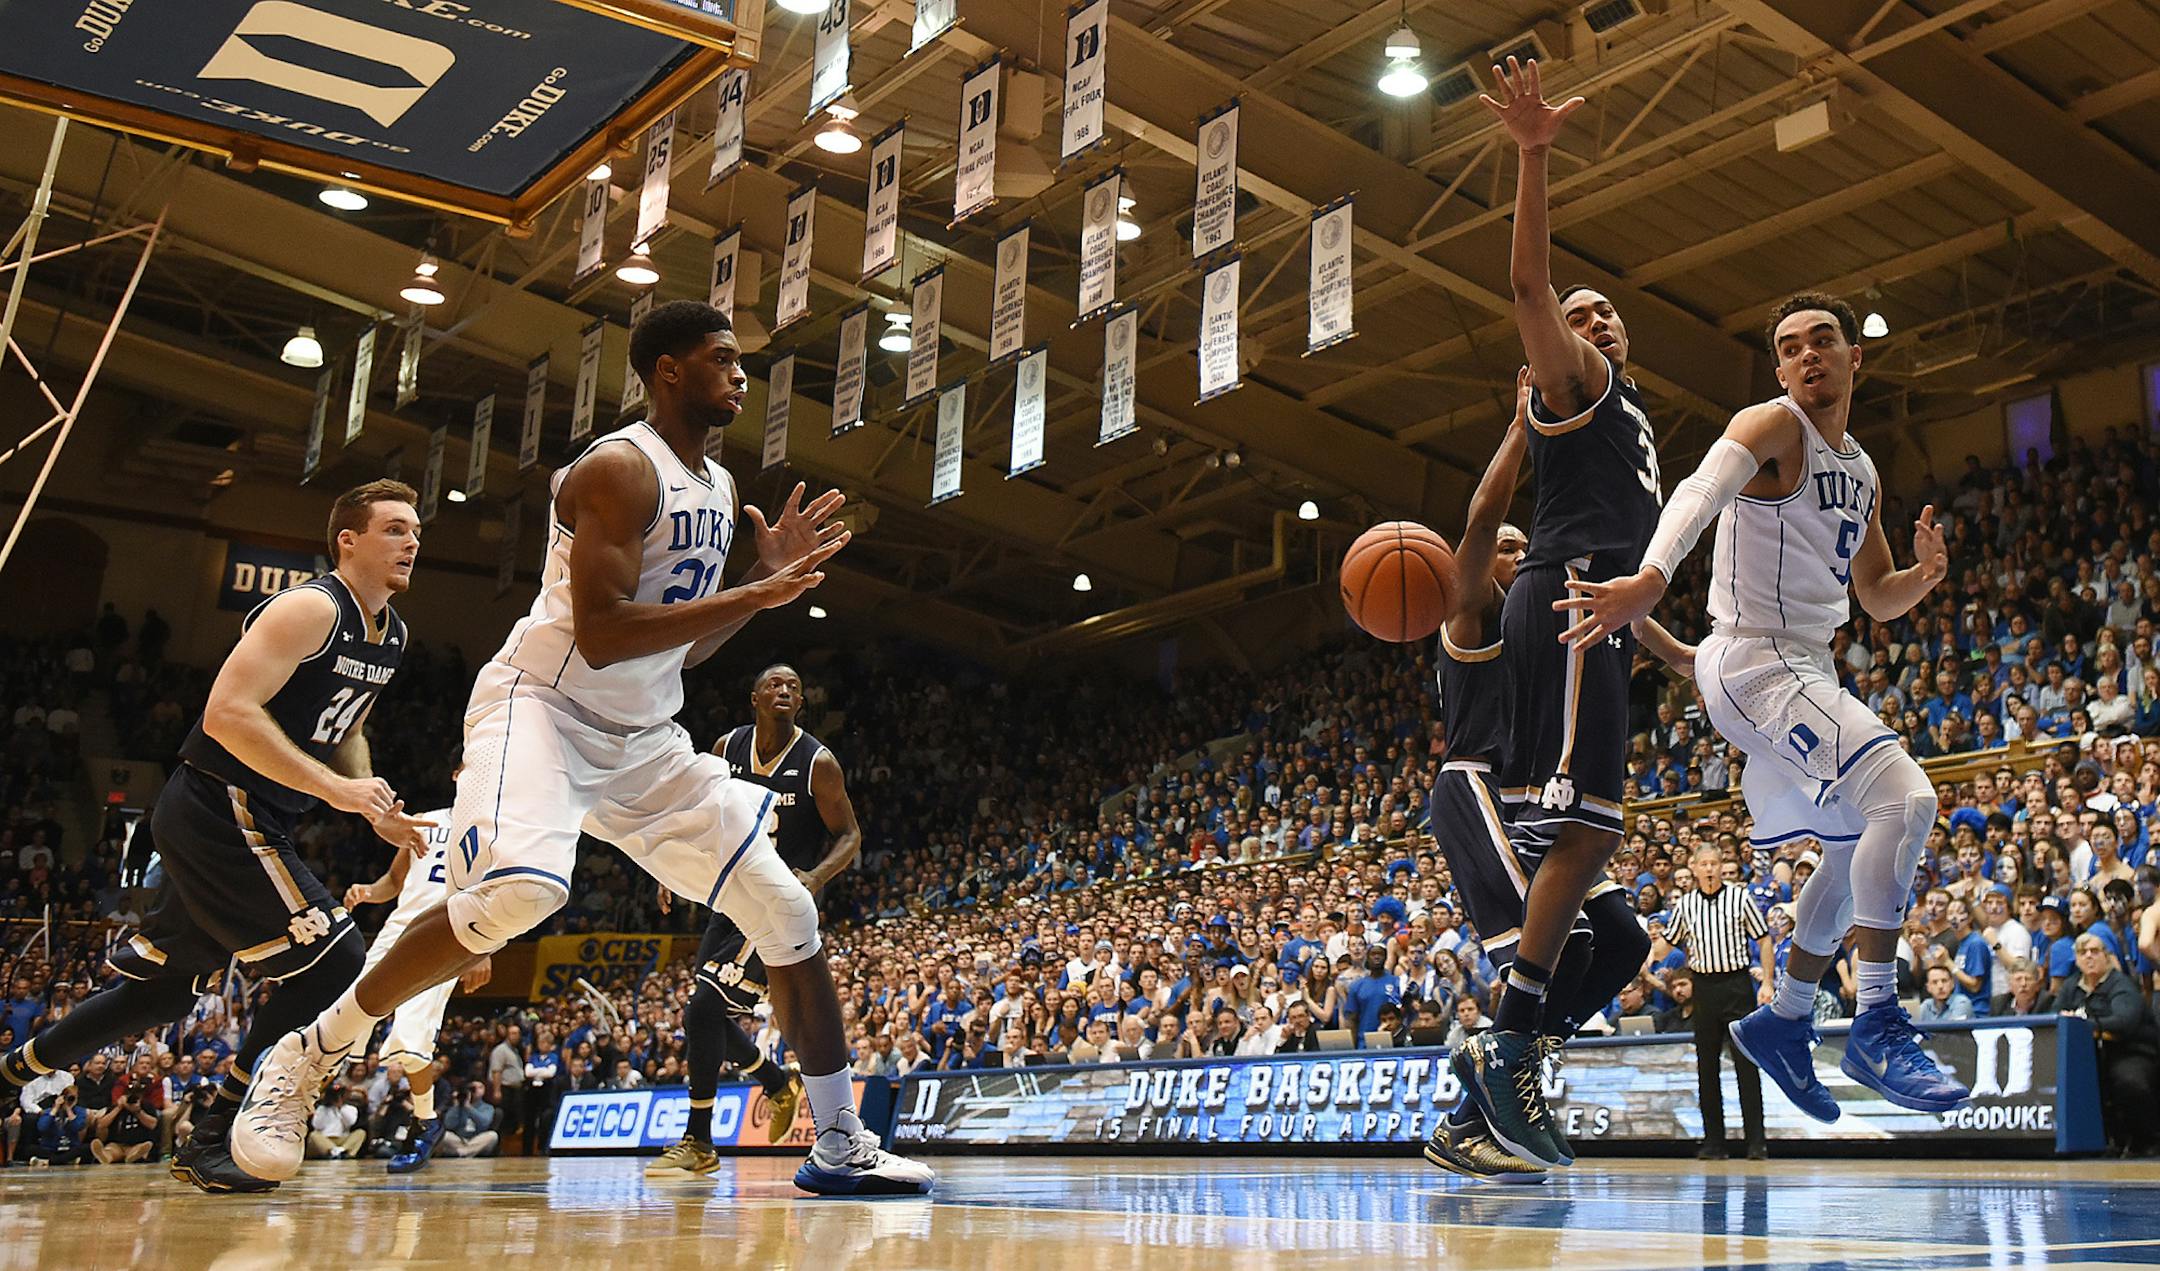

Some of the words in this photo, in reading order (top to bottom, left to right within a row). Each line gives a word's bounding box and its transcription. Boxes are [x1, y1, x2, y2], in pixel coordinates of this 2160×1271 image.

[719, 75, 743, 114] 44
[648, 137, 670, 176] 25
[587, 185, 604, 218] 10
[1206, 176, 1226, 195] COAST
[1318, 255, 1345, 274] ATLANTIC
[1636, 428, 1663, 508] 3
[1829, 519, 1860, 586] 5
[232, 562, 314, 596] DUK
[332, 655, 366, 681] NOTRE
[310, 686, 373, 744] 24
[603, 938, 662, 962] CBS
[1124, 1067, 1231, 1110] DUKE
[1245, 1053, 1567, 1106] BASKETBL
[562, 1102, 641, 1138] GEICO
[648, 1095, 741, 1140] GEO
[1095, 1117, 1122, 1139] 15
[1138, 1115, 1218, 1139] FINAL
[1240, 1112, 1317, 1138] FOUR
